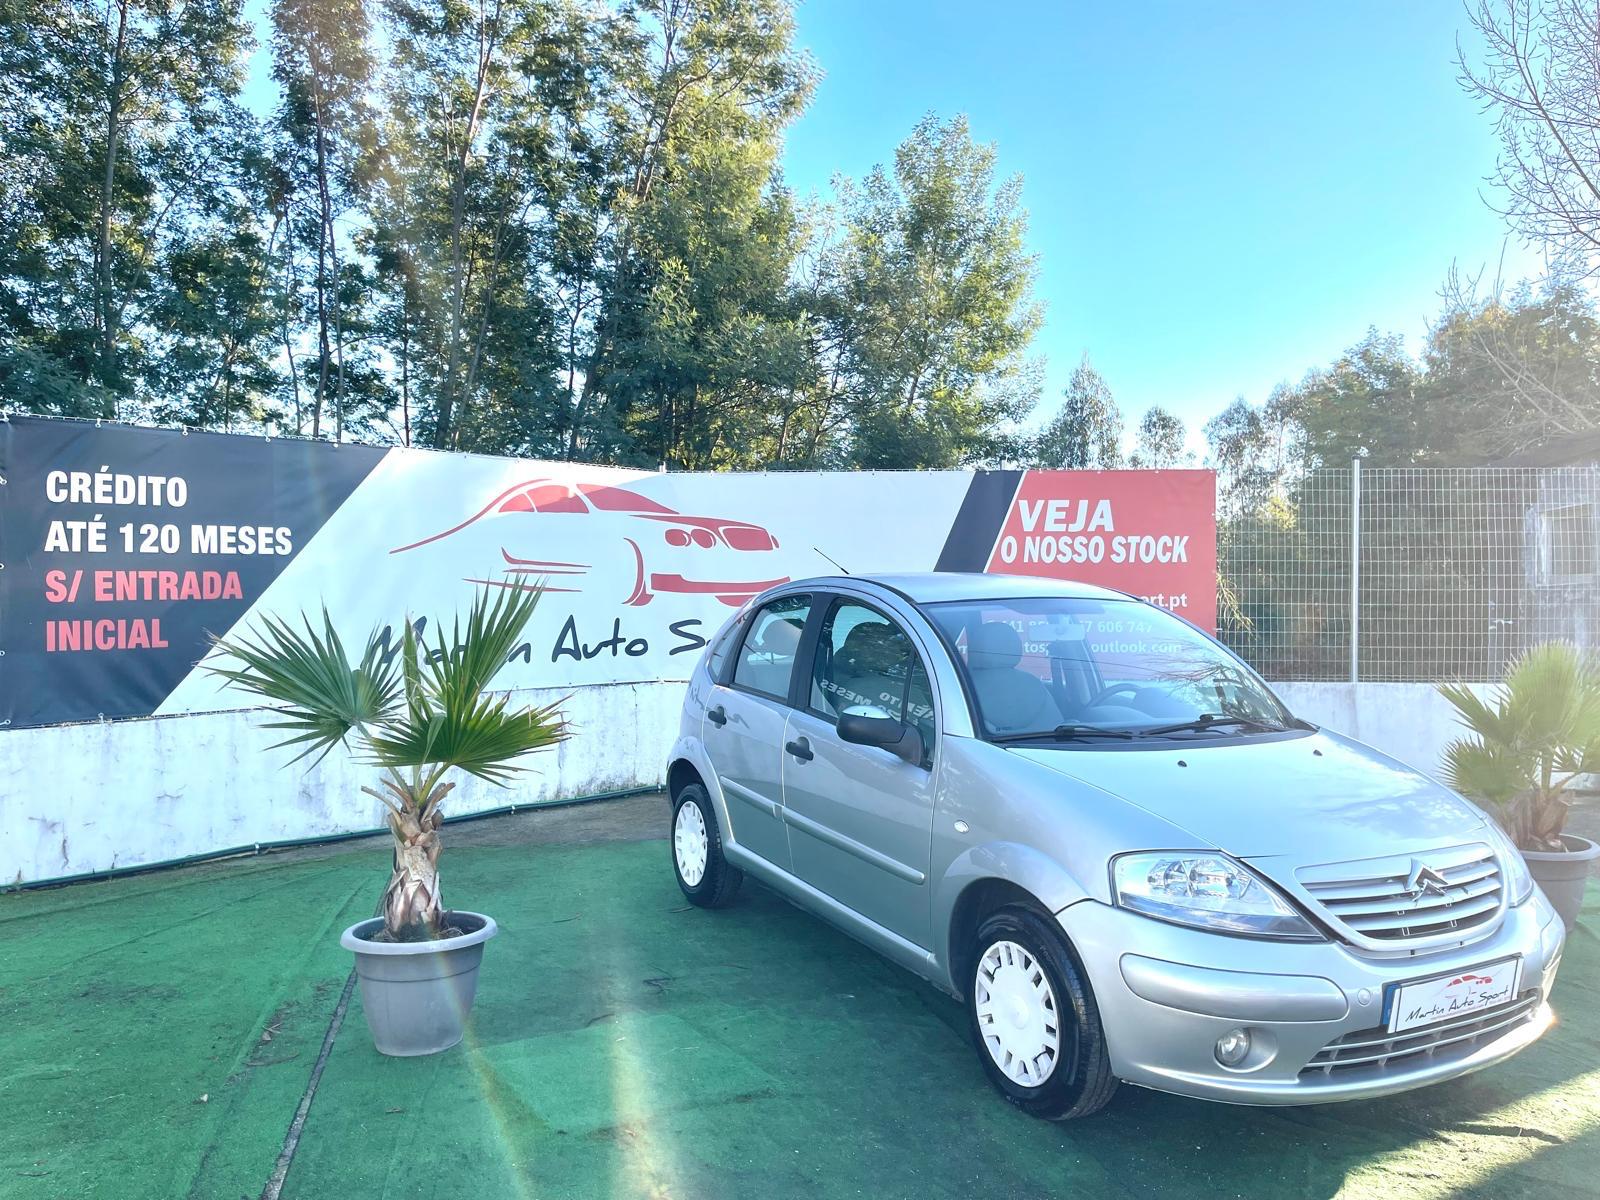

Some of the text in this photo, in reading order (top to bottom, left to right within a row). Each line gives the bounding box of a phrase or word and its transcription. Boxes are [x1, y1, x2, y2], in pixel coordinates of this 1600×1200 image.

[46, 465, 188, 507] CRÉDITO
[1018, 499, 1115, 532] VEJA
[44, 514, 293, 555] ATÉ 120 MESES
[1000, 535, 1189, 564] O NOSSO STOCK
[45, 569, 243, 603] S/ ENTRADA
[1140, 592, 1188, 611] ort.pt
[46, 618, 169, 652] INICIAL
[551, 614, 649, 663] Auto
[1098, 621, 1123, 633] 606
[1405, 1005, 1445, 1022] Martin
[1448, 996, 1475, 1012] Auto
[1478, 985, 1509, 1006] Sport
